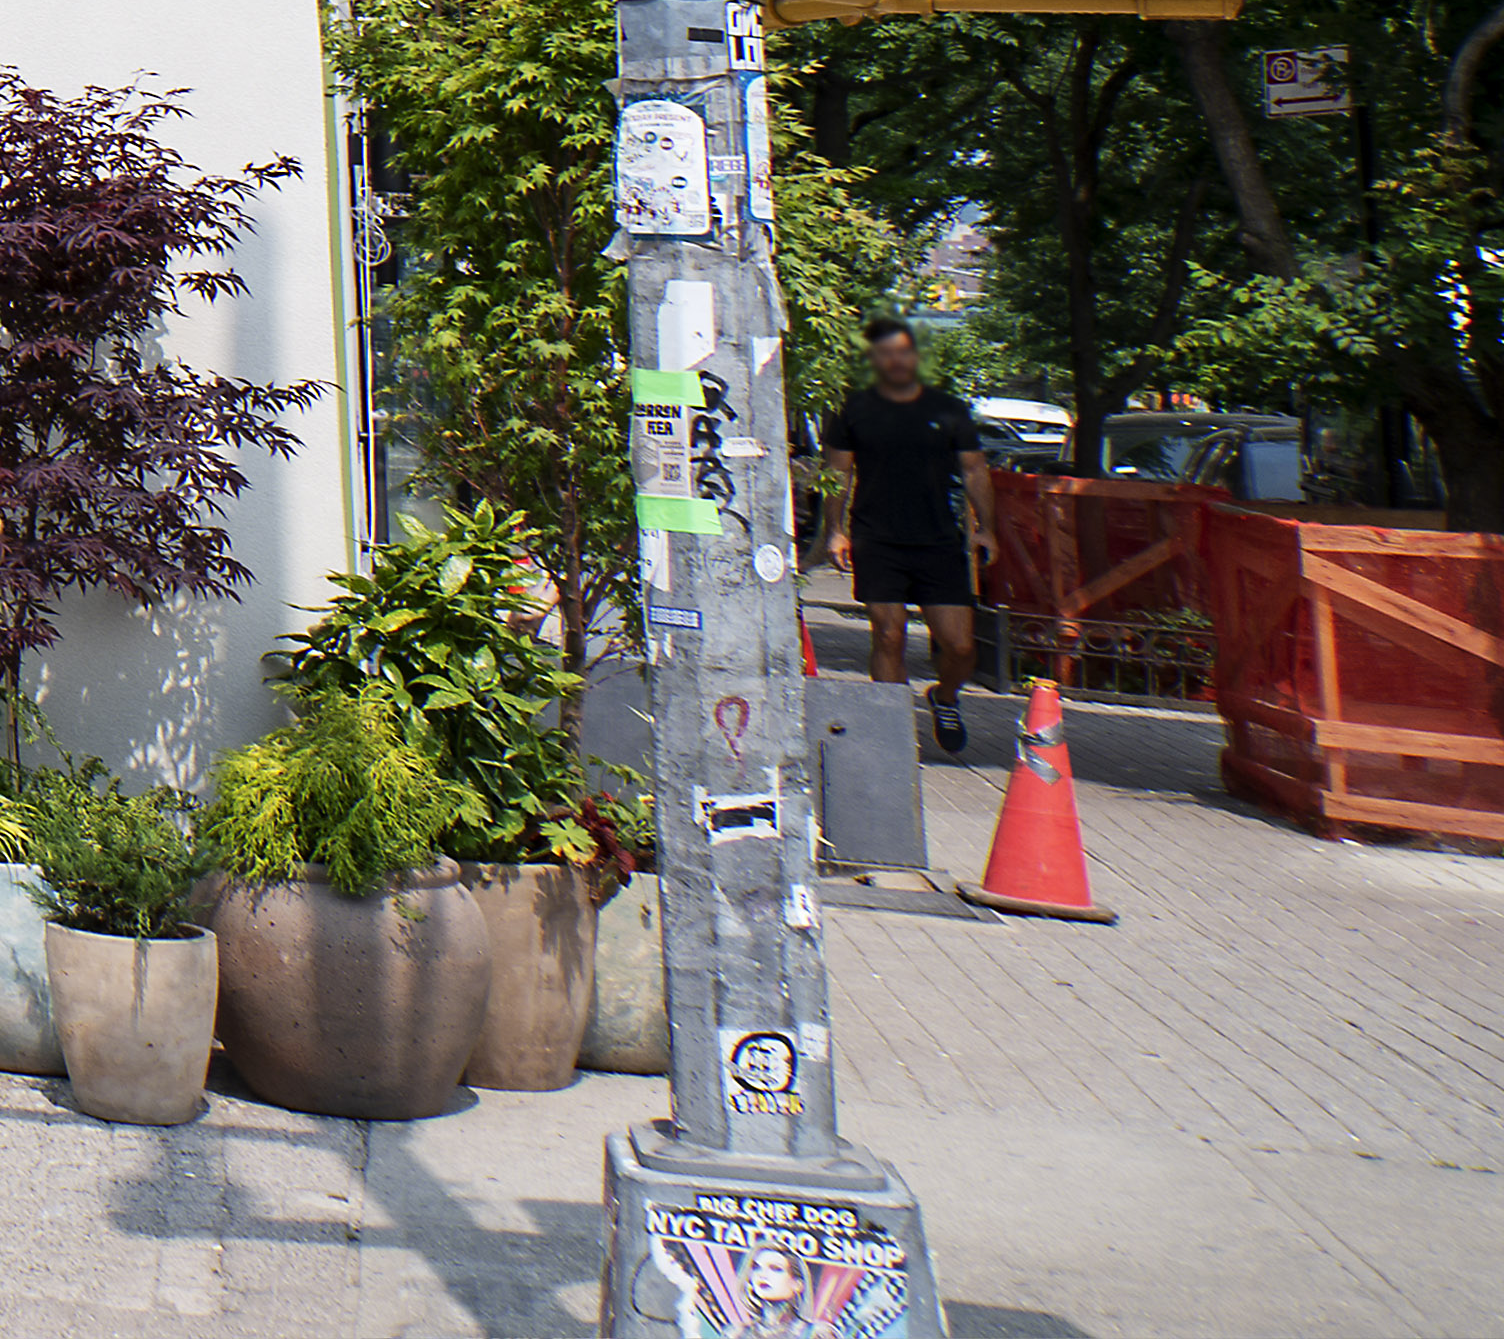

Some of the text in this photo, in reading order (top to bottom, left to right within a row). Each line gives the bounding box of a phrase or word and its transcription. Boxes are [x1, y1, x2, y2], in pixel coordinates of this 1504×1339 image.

[698, 1196, 859, 1229] BIG CHEF DOG
[647, 1209, 706, 1240] NYC
[821, 1235, 908, 1270] SHOP
